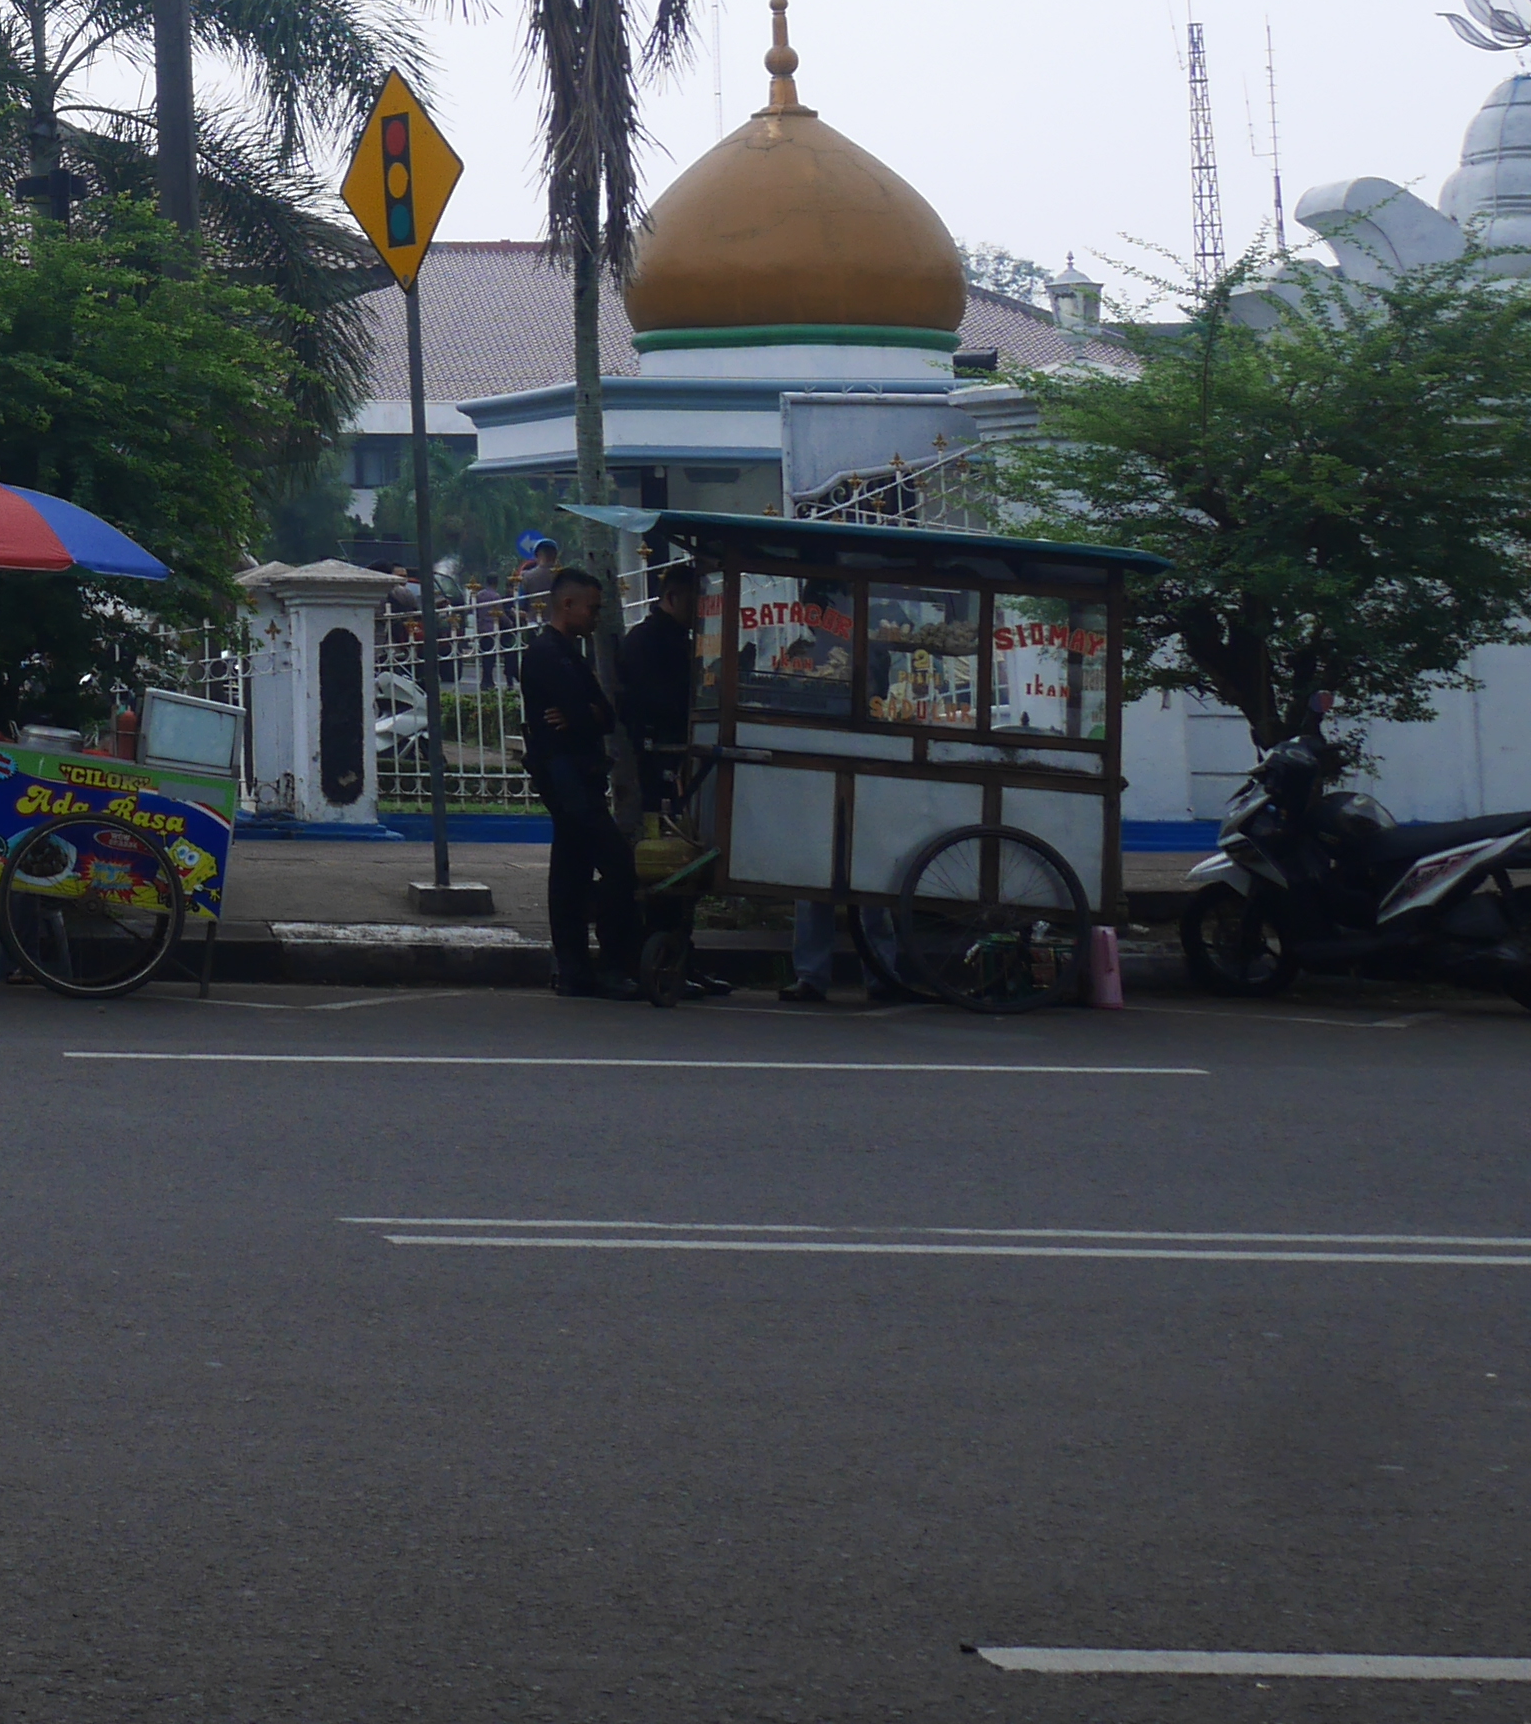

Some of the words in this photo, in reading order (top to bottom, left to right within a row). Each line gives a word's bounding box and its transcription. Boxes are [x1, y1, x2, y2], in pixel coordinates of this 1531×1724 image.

[739, 601, 854, 641] BATAGOR
[993, 622, 1106, 657] SIOMAY
[912, 648, 930, 669] 2
[15, 784, 91, 816] Ada
[101, 794, 186, 834] Rasa
